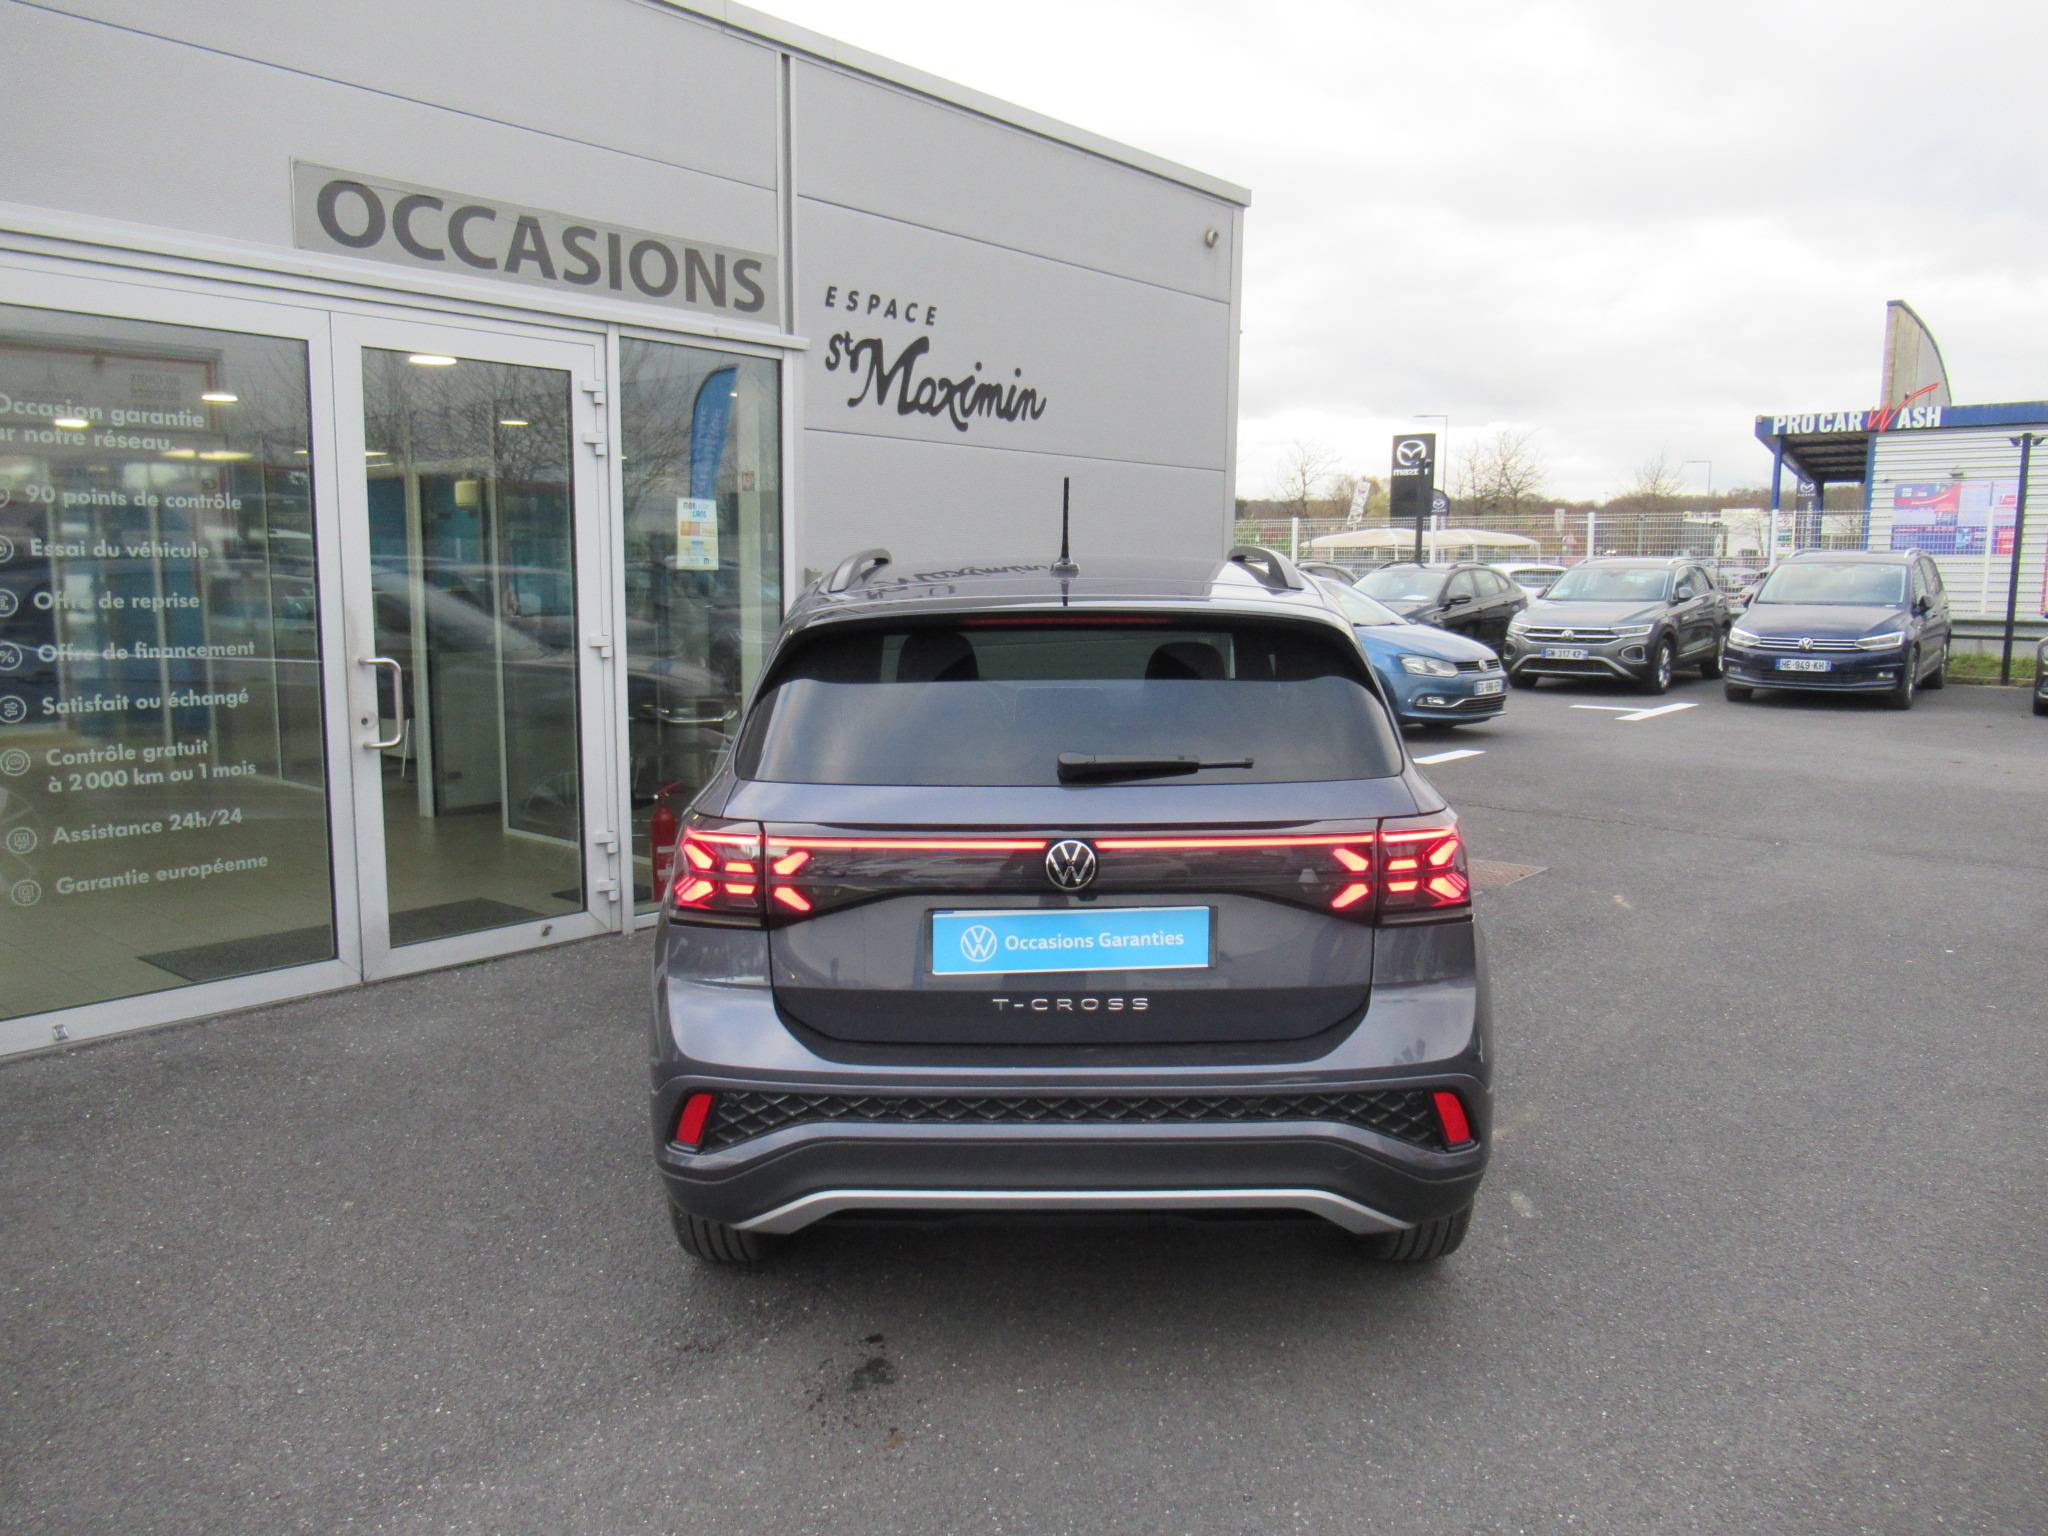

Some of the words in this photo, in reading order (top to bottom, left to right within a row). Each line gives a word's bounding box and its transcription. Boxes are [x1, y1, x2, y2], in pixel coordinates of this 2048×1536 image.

[316, 179, 765, 313] OCCASIONS
[825, 286, 937, 326] ESPACE
[847, 336, 1047, 432] Maximin
[110, 409, 205, 429] garantie
[1773, 413, 1814, 436] PRO
[1818, 411, 1864, 434] CAR
[1867, 384, 1942, 433] WASH
[24, 427, 87, 446] notre
[94, 430, 177, 450] réseau.
[25, 484, 56, 504] 90
[63, 488, 128, 509] points
[134, 489, 160, 507] de
[165, 491, 242, 510] contrôle
[30, 538, 86, 557] Essai
[93, 539, 119, 558] du
[127, 541, 209, 559] véhicule
[34, 591, 92, 610] Offre
[99, 590, 124, 609] de
[132, 592, 200, 612] reprise
[38, 642, 96, 662] Offre
[102, 641, 128, 660] de
[134, 640, 255, 660] financement
[42, 693, 129, 716] Satisfait
[136, 696, 160, 710] ou
[168, 687, 249, 709] échangé
[46, 744, 136, 766] Contrôle
[143, 739, 209, 762] gratuit
[48, 776, 62, 793] à
[133, 768, 164, 785] km
[170, 768, 194, 782] ou
[199, 763, 207, 779] 1
[213, 760, 256, 778] mois
[53, 821, 163, 844] Assistance
[169, 808, 243, 832] 24h/24
[56, 868, 149, 895] Garantie
[156, 855, 268, 882] européenne
[1005, 933, 1094, 951] Occasions
[1099, 931, 1185, 947] Garanties
[993, 998, 1149, 1011] T-CROSS
